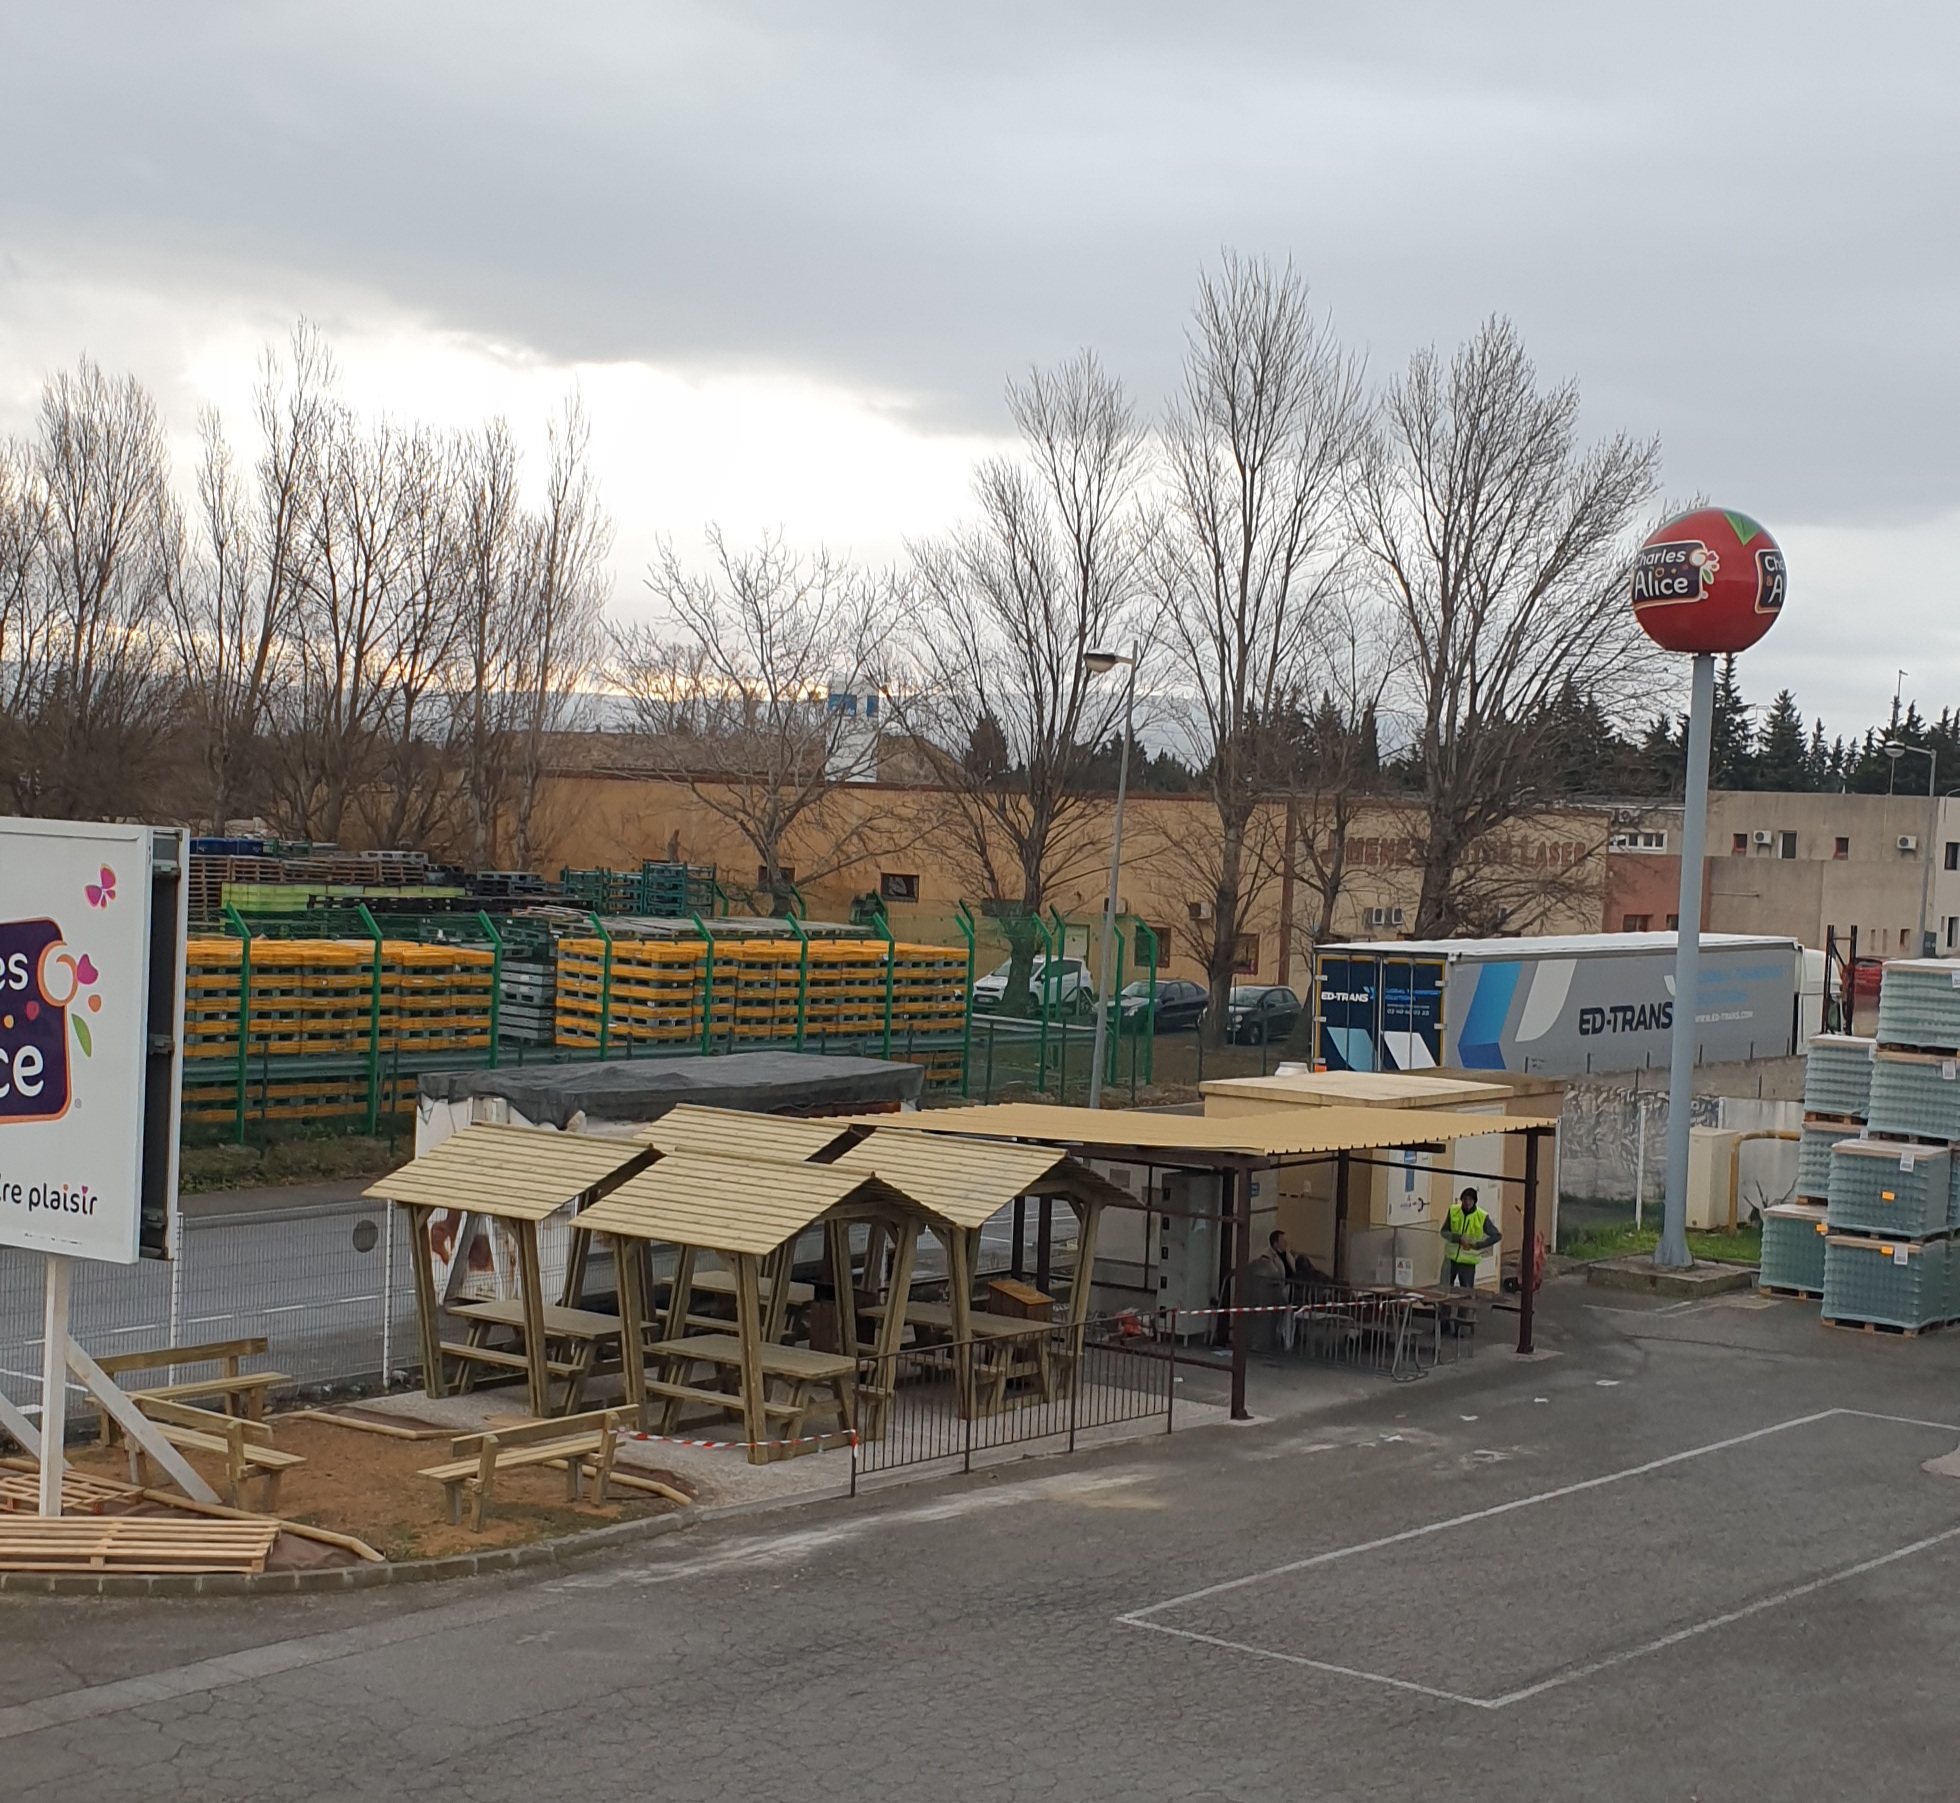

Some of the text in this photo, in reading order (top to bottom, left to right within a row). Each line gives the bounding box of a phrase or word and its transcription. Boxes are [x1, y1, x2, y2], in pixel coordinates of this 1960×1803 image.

[1634, 570, 1689, 600] Alice
[0, 953, 29, 991] s
[1321, 991, 1369, 1002] ED-TRANS
[1579, 1002, 1673, 1035] ED-TRANS
[0, 1173, 98, 1215] re plaisir
